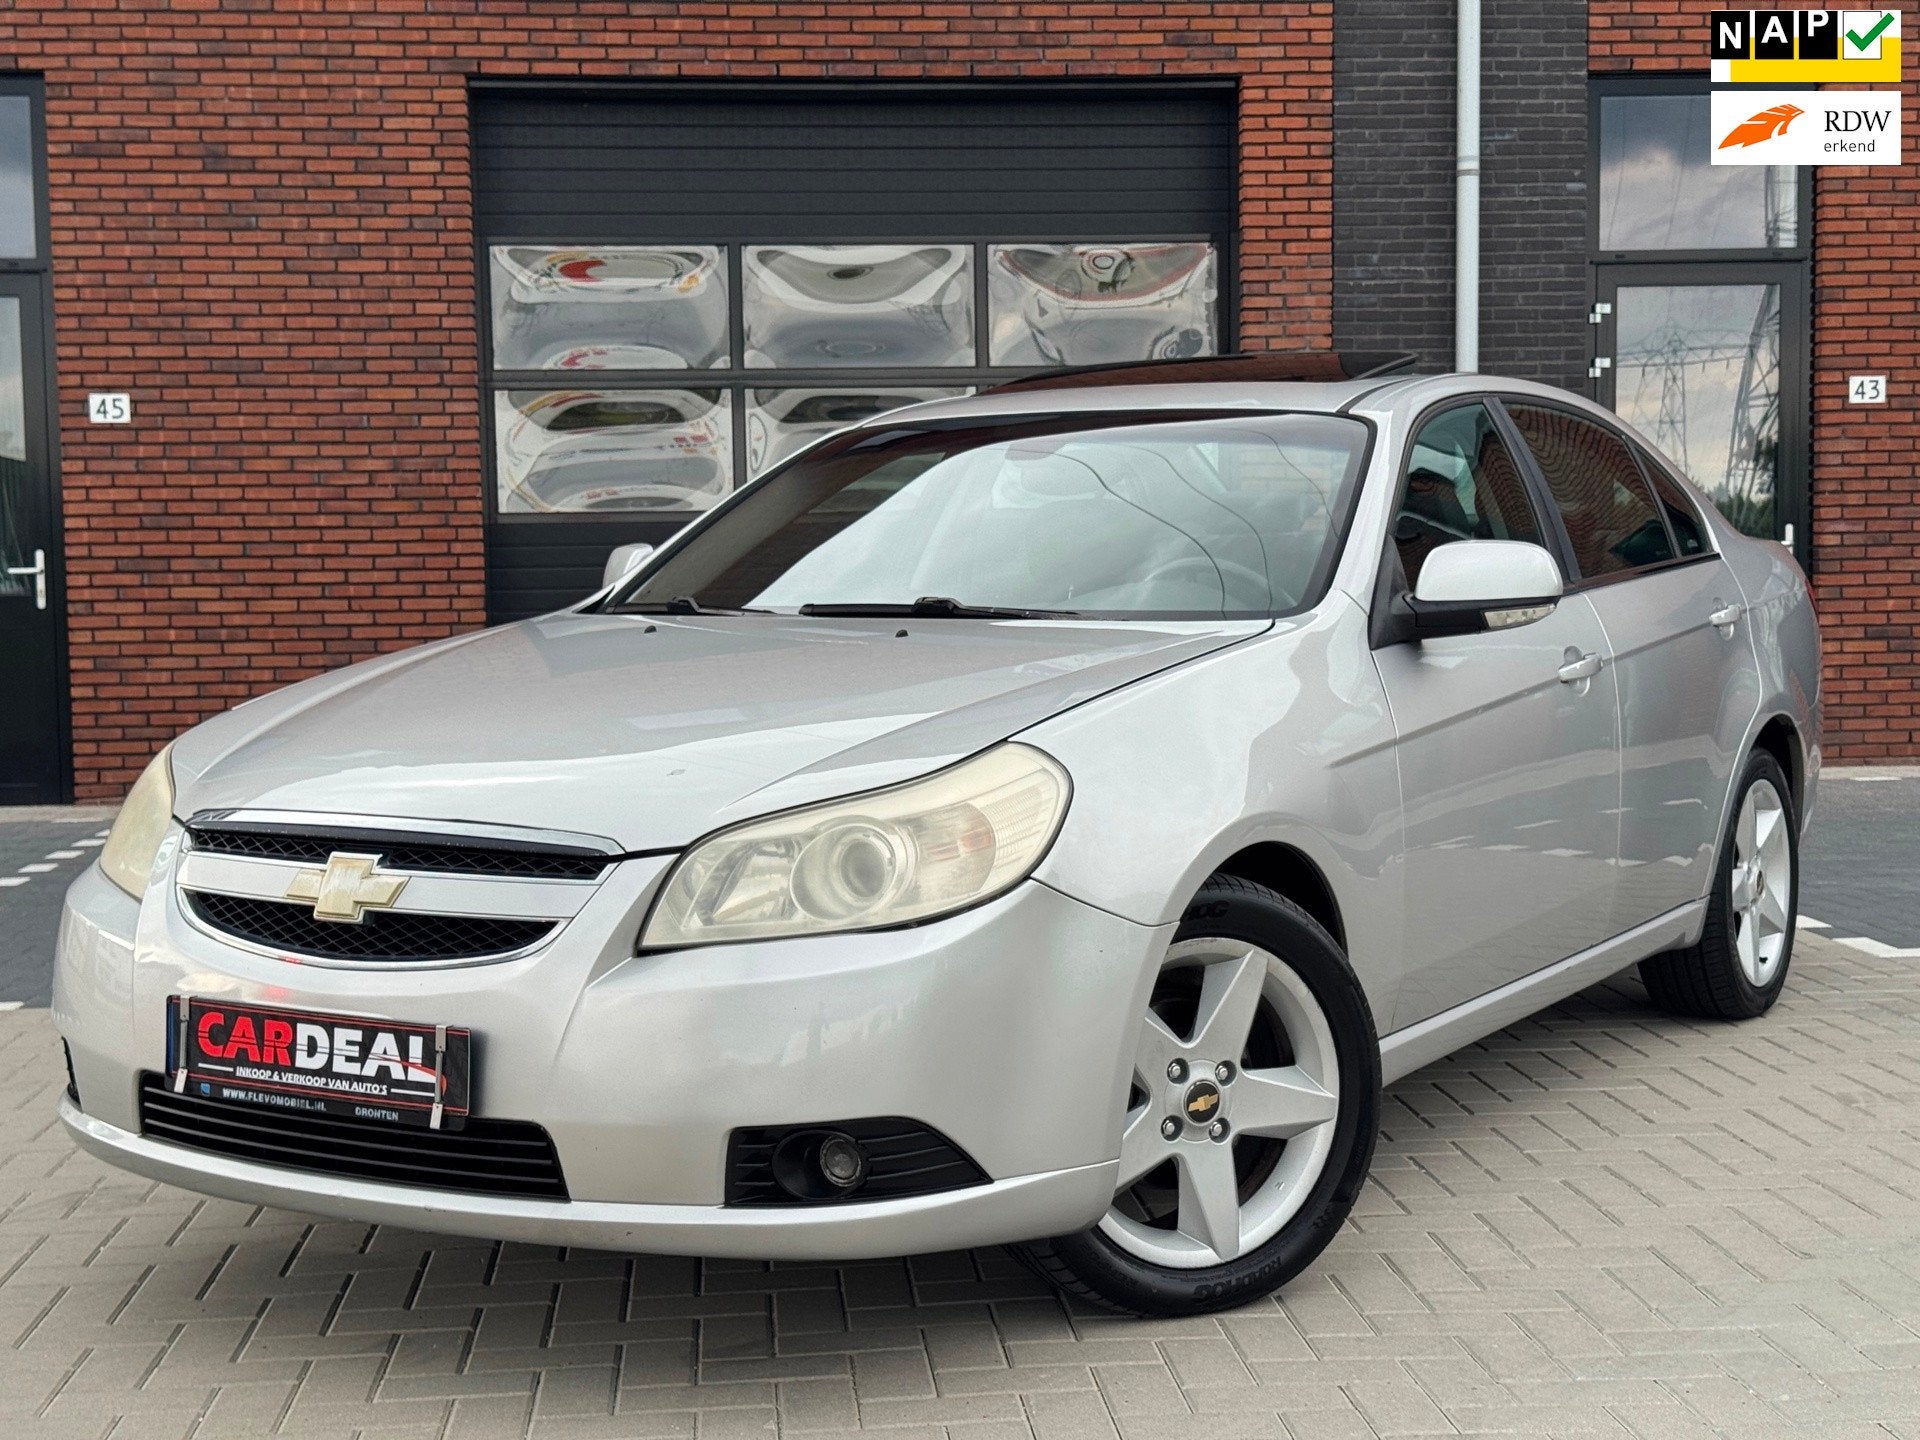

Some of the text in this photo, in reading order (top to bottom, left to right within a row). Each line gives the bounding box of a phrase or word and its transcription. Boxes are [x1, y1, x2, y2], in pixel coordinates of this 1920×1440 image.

[1854, 379, 1880, 400] 43
[96, 398, 125, 419] 45
[197, 1011, 436, 1084] CARDEAL
[235, 1065, 388, 1096] INKOOP & VERKOOP VAN AUTO'S
[355, 1106, 399, 1121] DRONTEN
